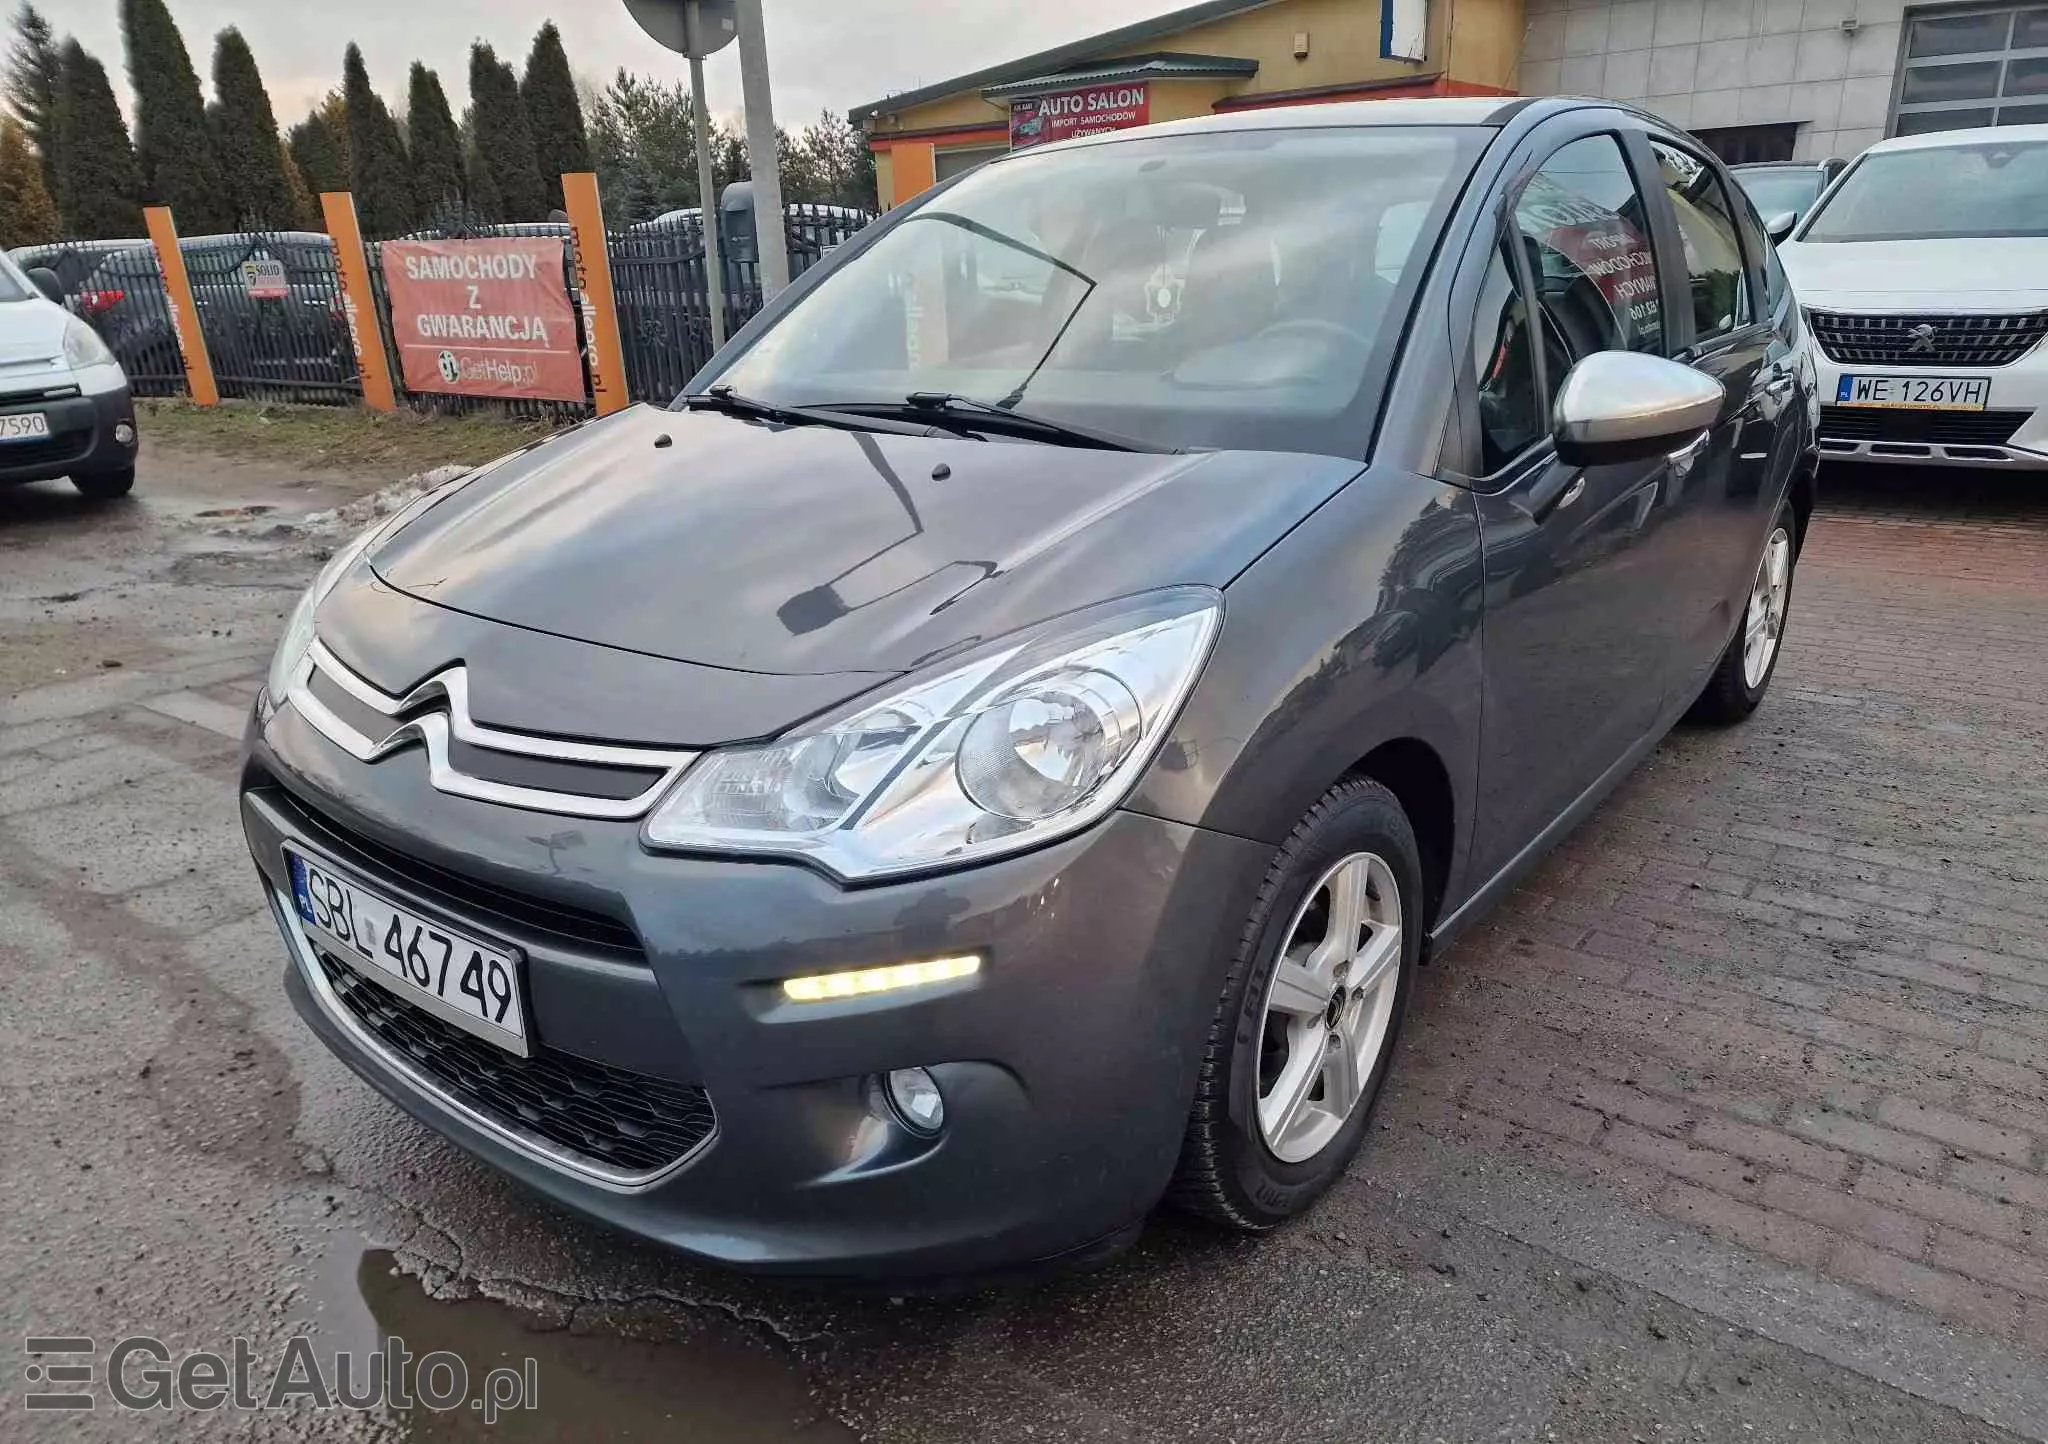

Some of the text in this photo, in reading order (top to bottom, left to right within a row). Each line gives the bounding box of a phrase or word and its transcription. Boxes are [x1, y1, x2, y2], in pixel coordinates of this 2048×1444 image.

[1039, 95, 1083, 117] AUTO
[1088, 87, 1144, 111] SALON
[1051, 117, 1077, 128] IMPORT
[405, 253, 537, 280] SAMOCHODY
[465, 285, 482, 309] Z
[417, 314, 550, 348] GWARANCJĄ
[1857, 379, 1888, 400] WE
[1902, 380, 1982, 403] 126VH
[0, 415, 45, 435] 7590
[309, 868, 373, 959] SBL
[384, 913, 511, 1023] 46749
